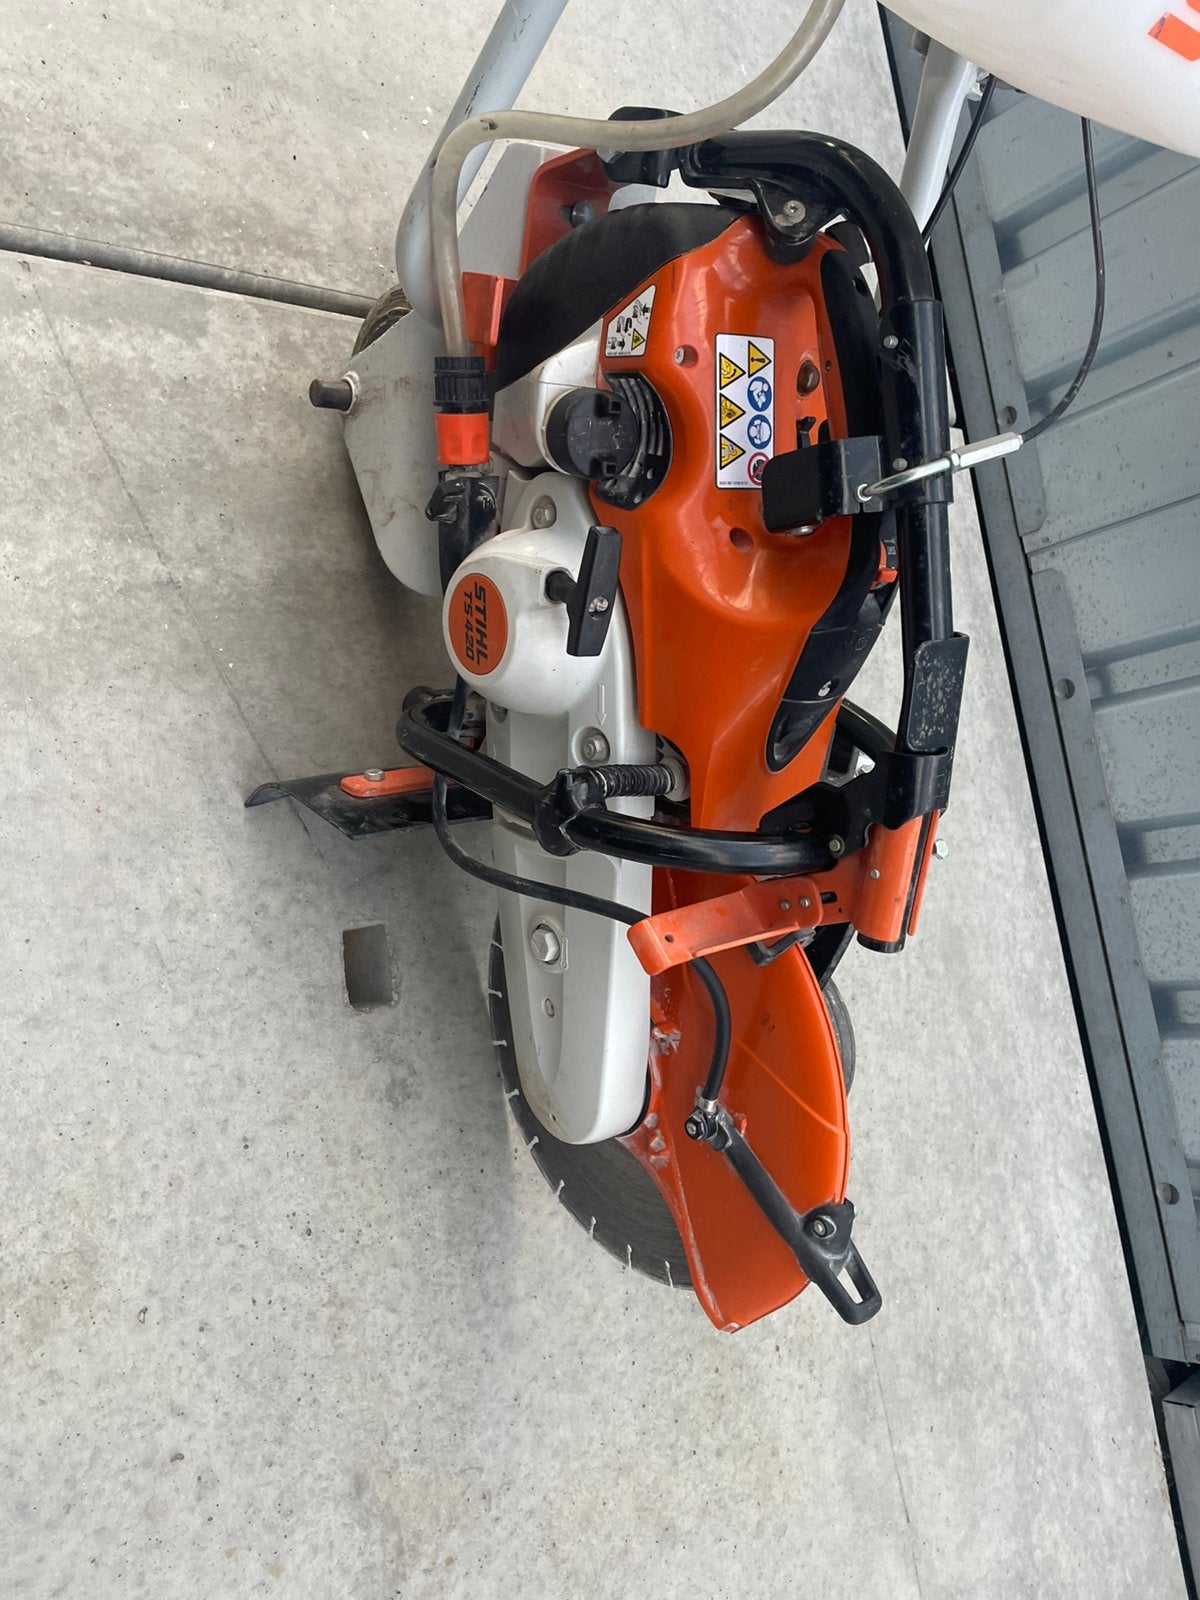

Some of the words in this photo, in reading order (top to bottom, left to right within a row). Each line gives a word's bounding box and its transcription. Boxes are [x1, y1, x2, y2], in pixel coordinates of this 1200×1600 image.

[464, 590, 473, 618] TS
[474, 581, 489, 665] STIHL
[465, 618, 475, 661] 420
